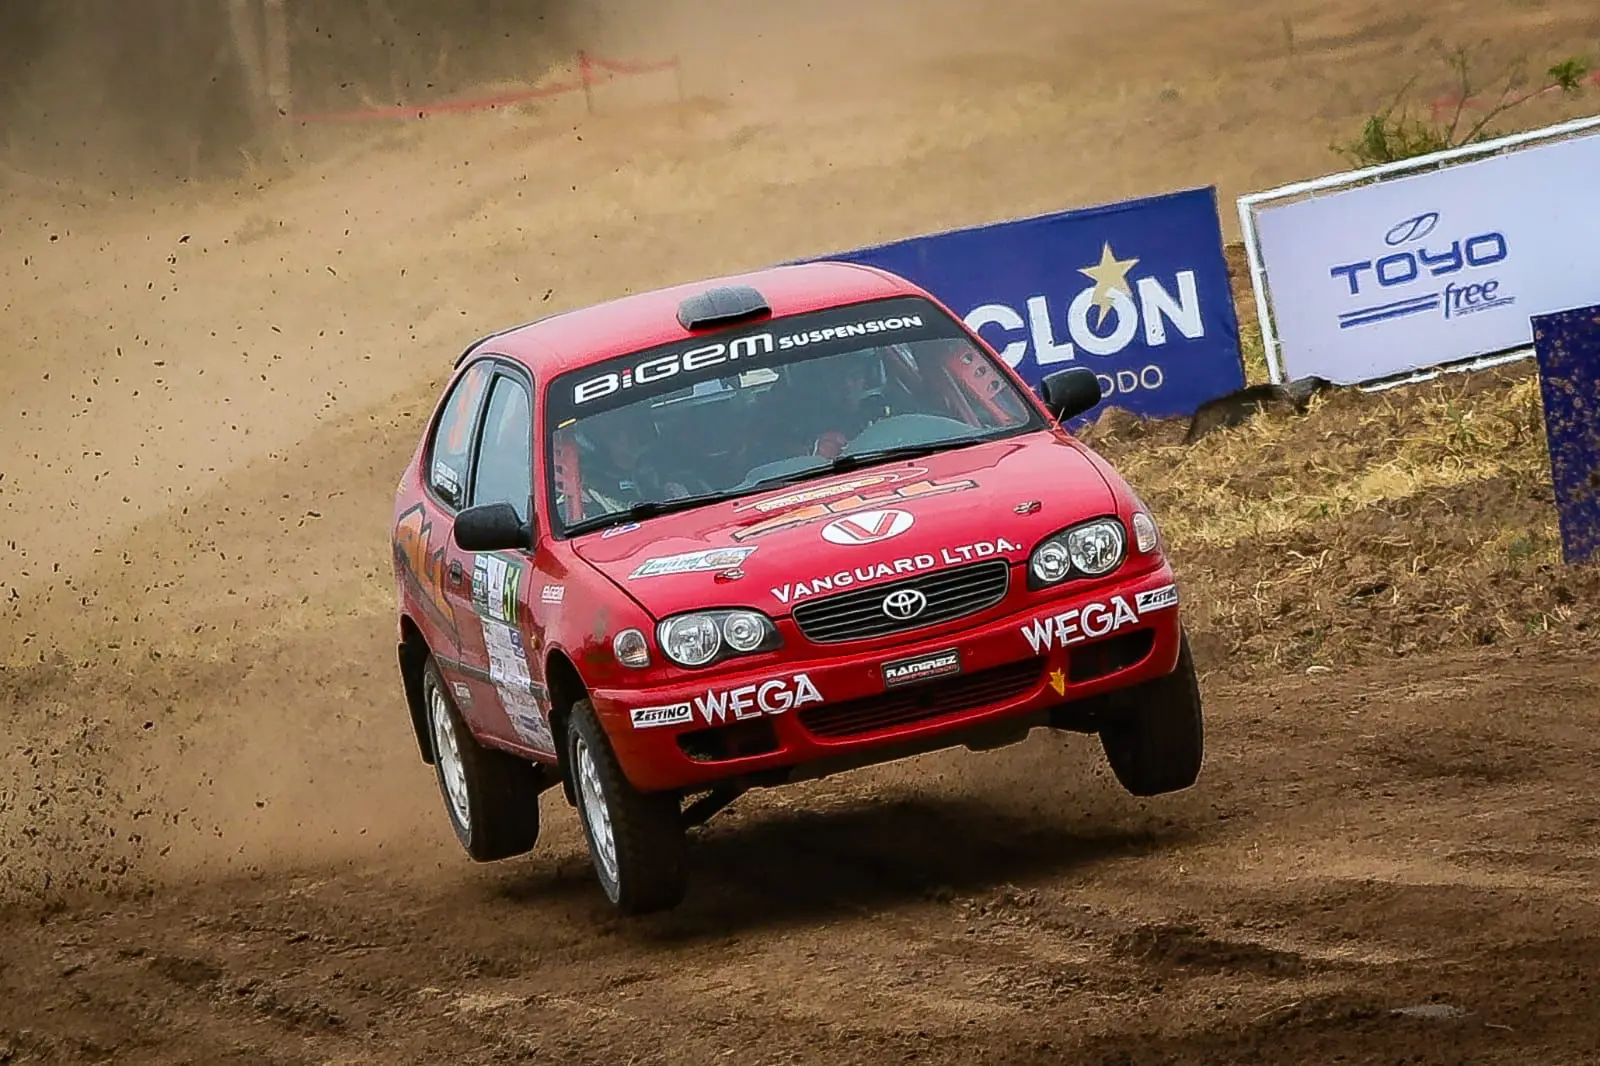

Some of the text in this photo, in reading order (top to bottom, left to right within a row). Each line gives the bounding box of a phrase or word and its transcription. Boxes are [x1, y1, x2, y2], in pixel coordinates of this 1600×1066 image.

[1330, 232, 1508, 295] TOYO
[1445, 280, 1499, 319] free
[779, 315, 924, 350] SUSPENSION
[771, 553, 935, 604] VANGUARD
[941, 537, 1023, 565] LTDA.
[1020, 594, 1139, 655] WEGA
[693, 672, 824, 726] WEGA
